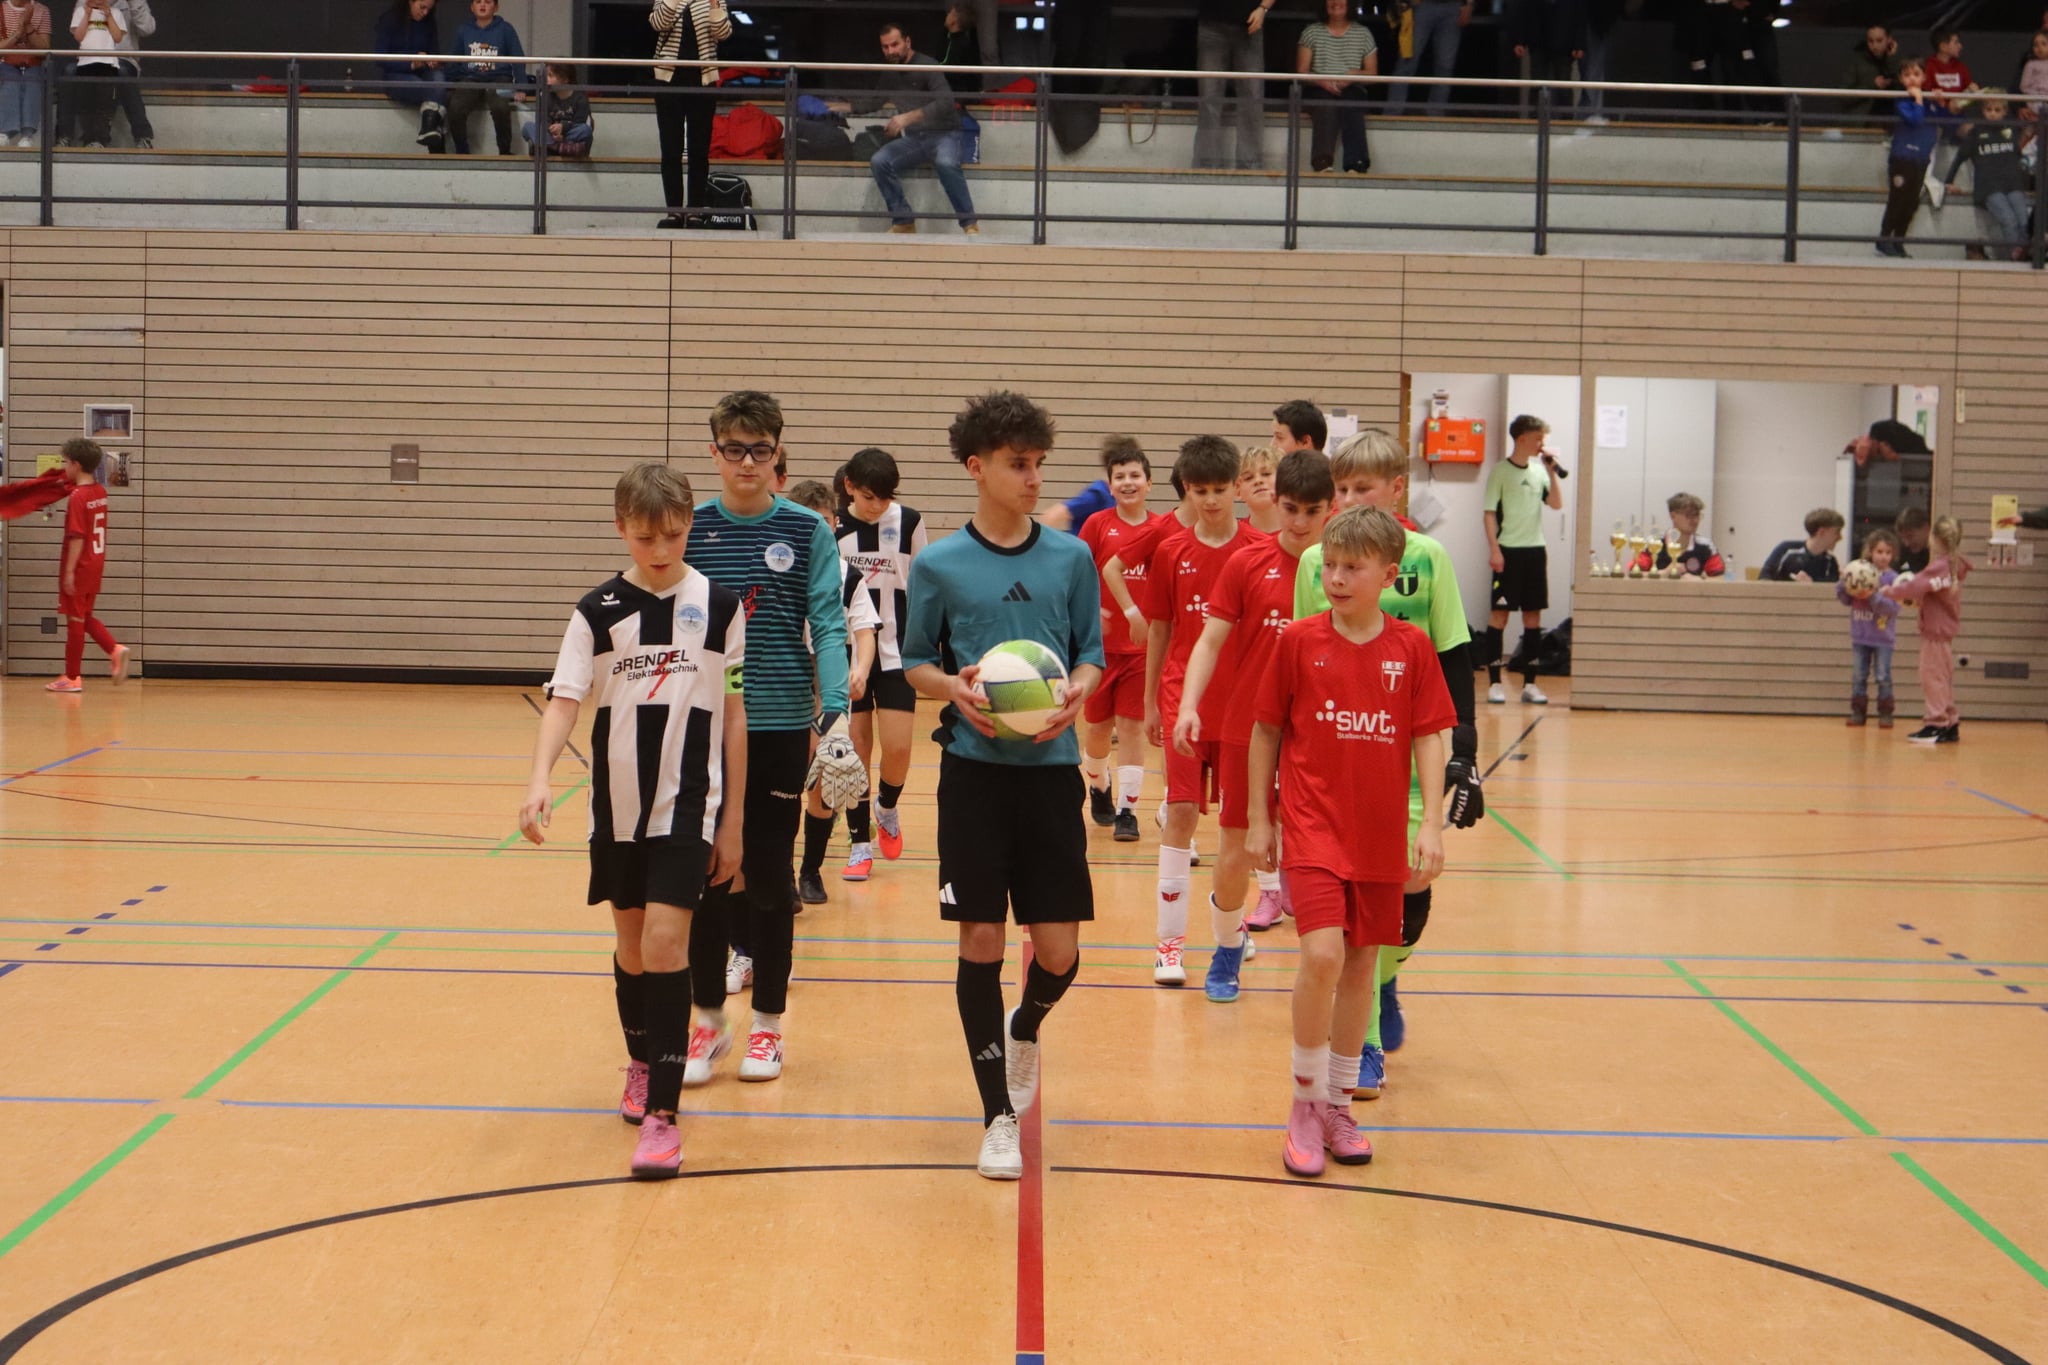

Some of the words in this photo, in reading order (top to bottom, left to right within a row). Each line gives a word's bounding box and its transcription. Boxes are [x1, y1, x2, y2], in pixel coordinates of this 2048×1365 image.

[711, 214, 742, 224] macron
[92, 512, 105, 555] 5
[612, 649, 690, 676] BRENDEL
[626, 663, 699, 681] Elektrotechnik
